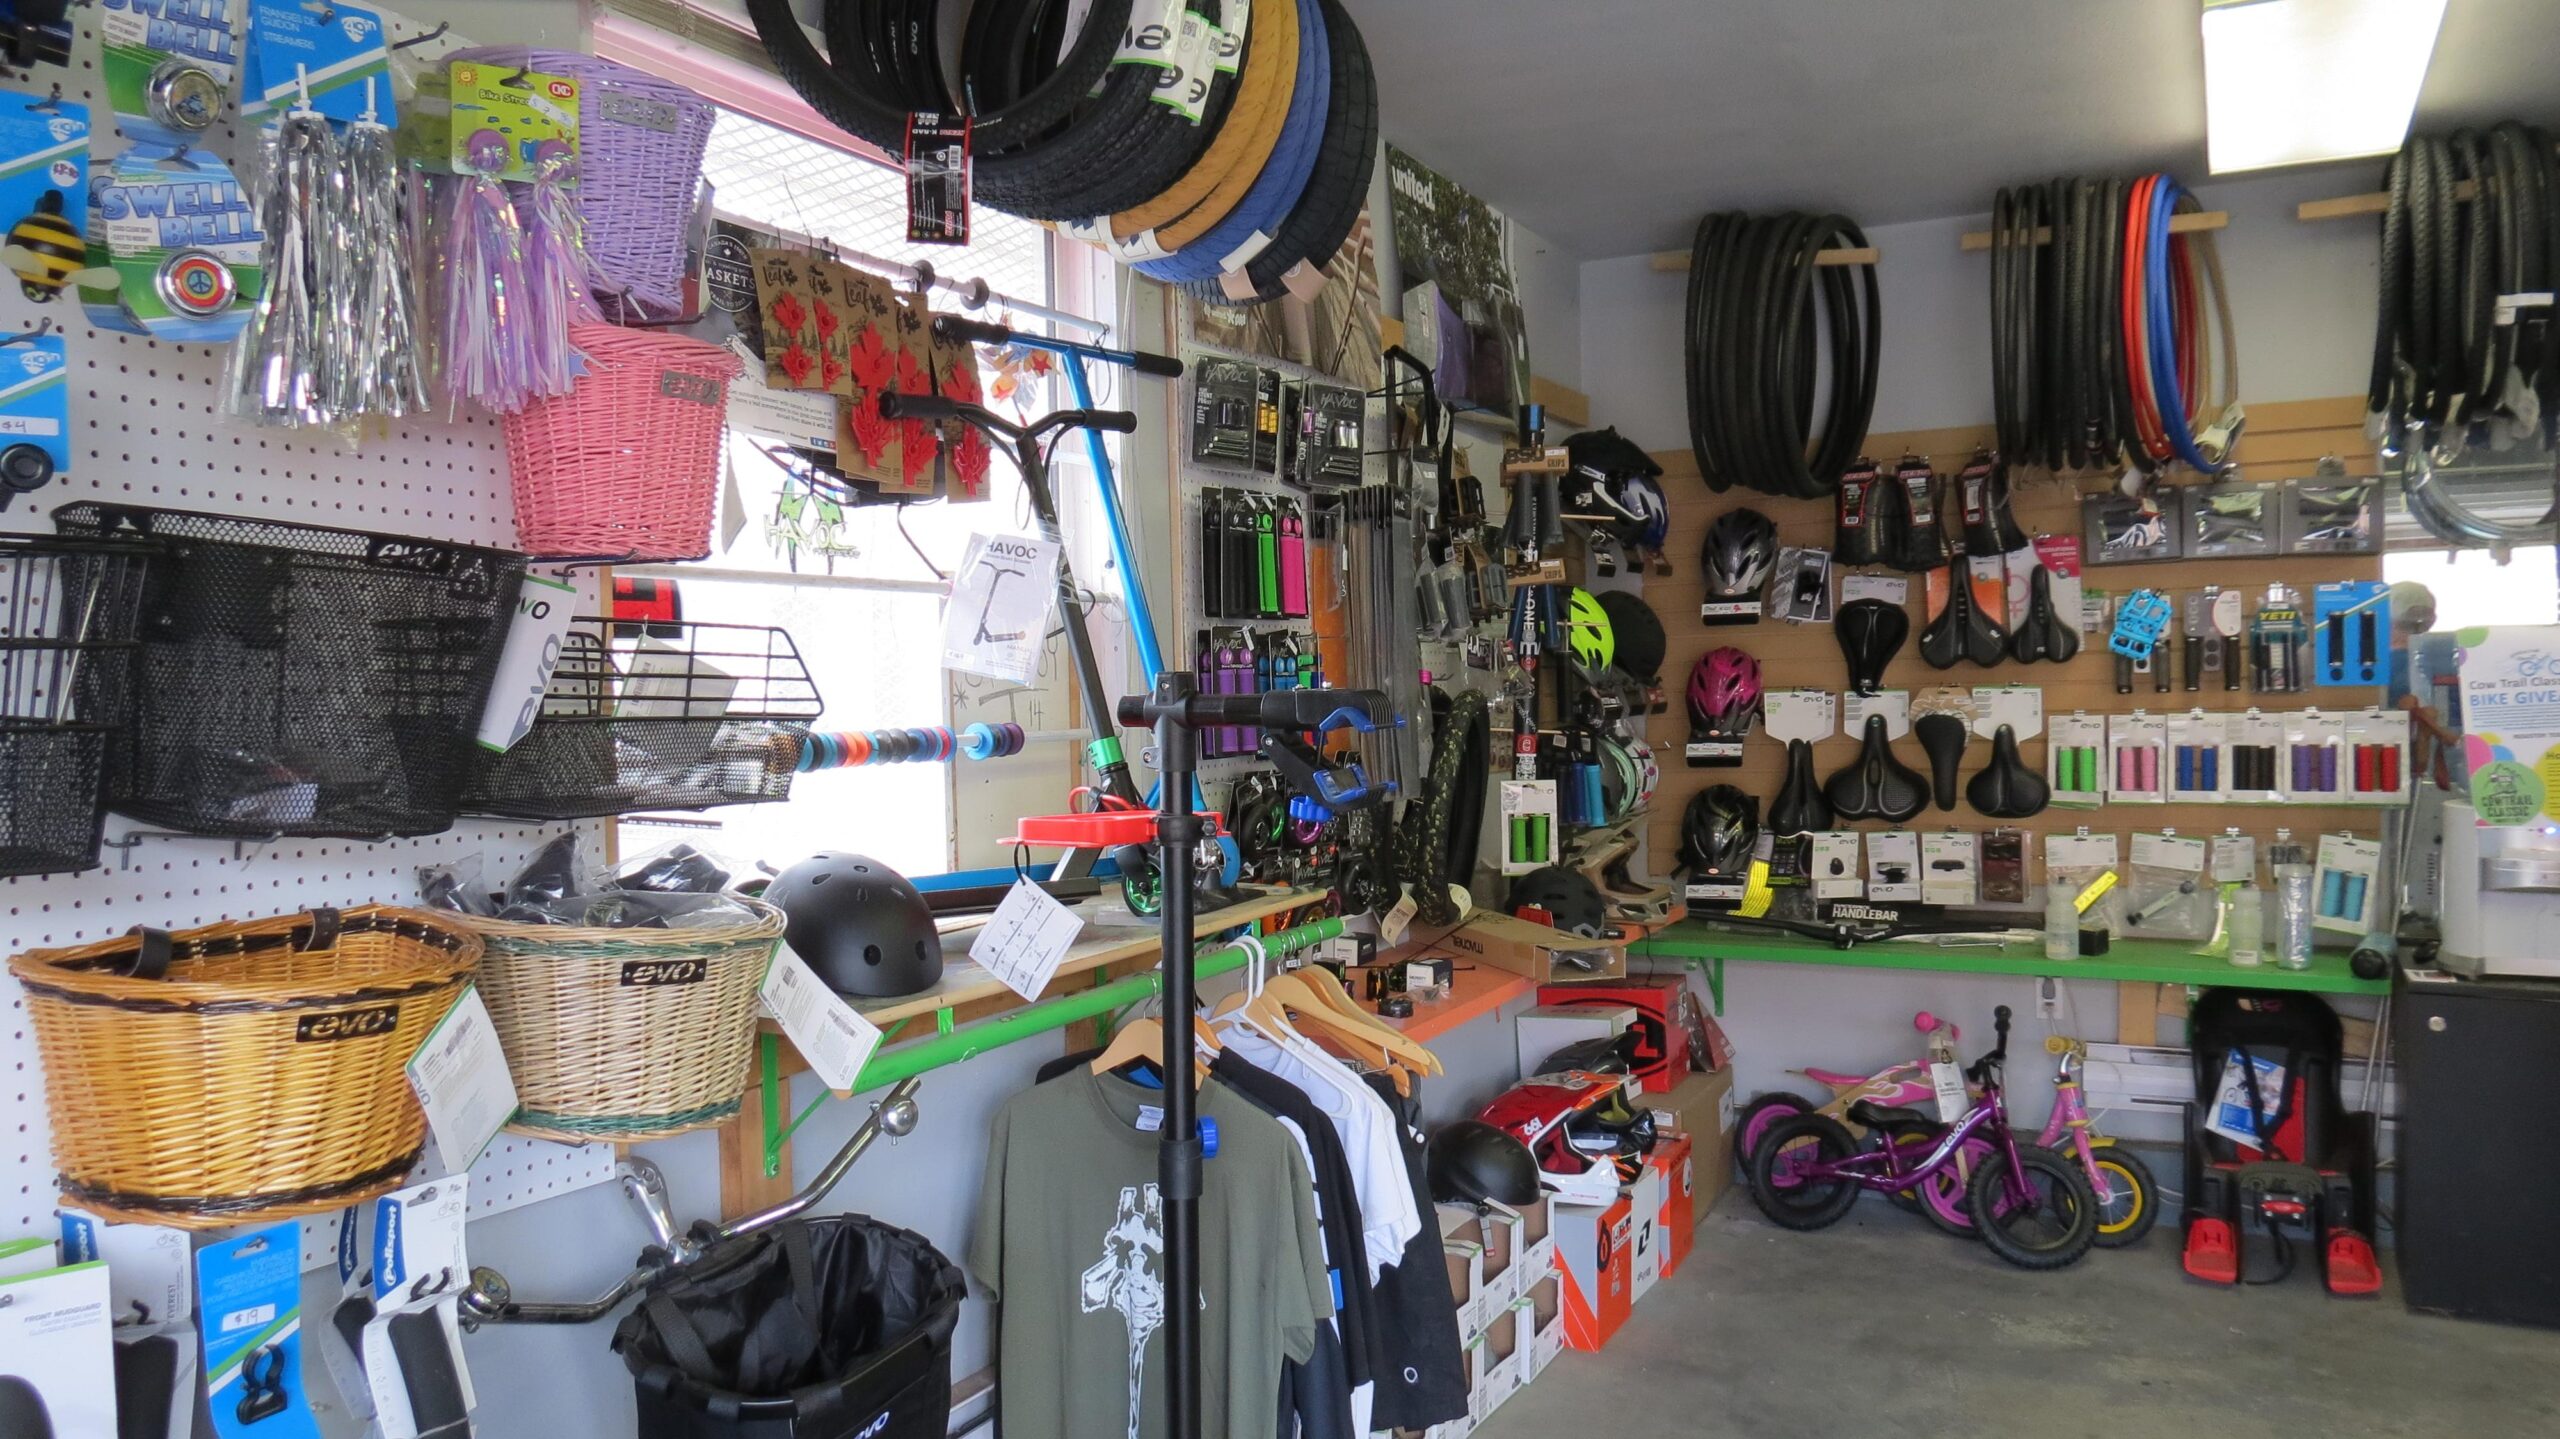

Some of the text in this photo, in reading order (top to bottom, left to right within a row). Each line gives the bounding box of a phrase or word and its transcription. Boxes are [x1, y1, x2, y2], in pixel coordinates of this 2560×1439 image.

[147, 18, 236, 65] BELL
[262, 31, 316, 50] STREAMERS
[479, 90, 500, 102] Bike
[102, 181, 252, 221] SWELL
[158, 211, 269, 248] BELL
[1205, 364, 1250, 383] HAVOC
[2259, 611, 2296, 621] YETI
[2470, 681, 2497, 690] Cow
[2500, 677, 2528, 688] Trail
[2470, 692, 2509, 706] BIKE
[2487, 806, 2530, 818] CLASSIC
[1832, 904, 1899, 922] HANDLEBAR
[631, 962, 697, 984] evo
[310, 1010, 388, 1038] evo
[1945, 1120, 1966, 1148] evo
[383, 1204, 398, 1287] Polisport
[167, 1284, 176, 1319] EVEREST
[24, 1302, 101, 1323] FRONT MUDGUARD
